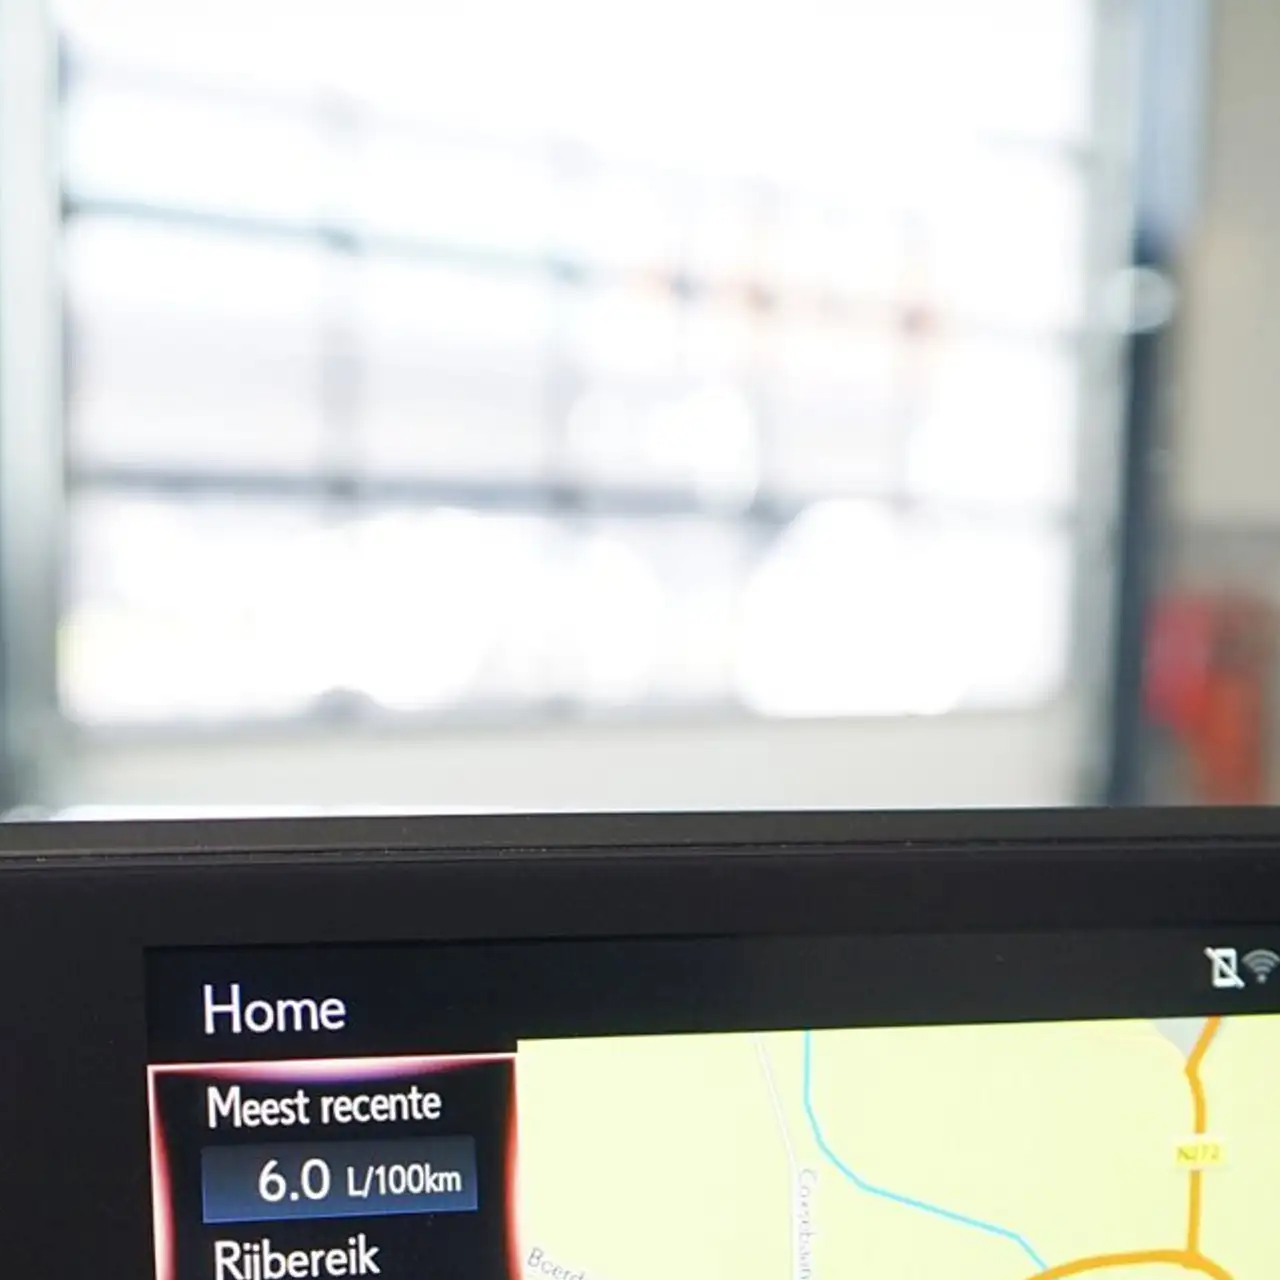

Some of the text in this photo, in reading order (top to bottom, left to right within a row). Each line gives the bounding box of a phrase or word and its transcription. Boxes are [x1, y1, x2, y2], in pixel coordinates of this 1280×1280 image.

[202, 983, 347, 1035] Home
[206, 1085, 442, 1128] Meest recente
[258, 1157, 462, 1201] 6.0 L/100km
